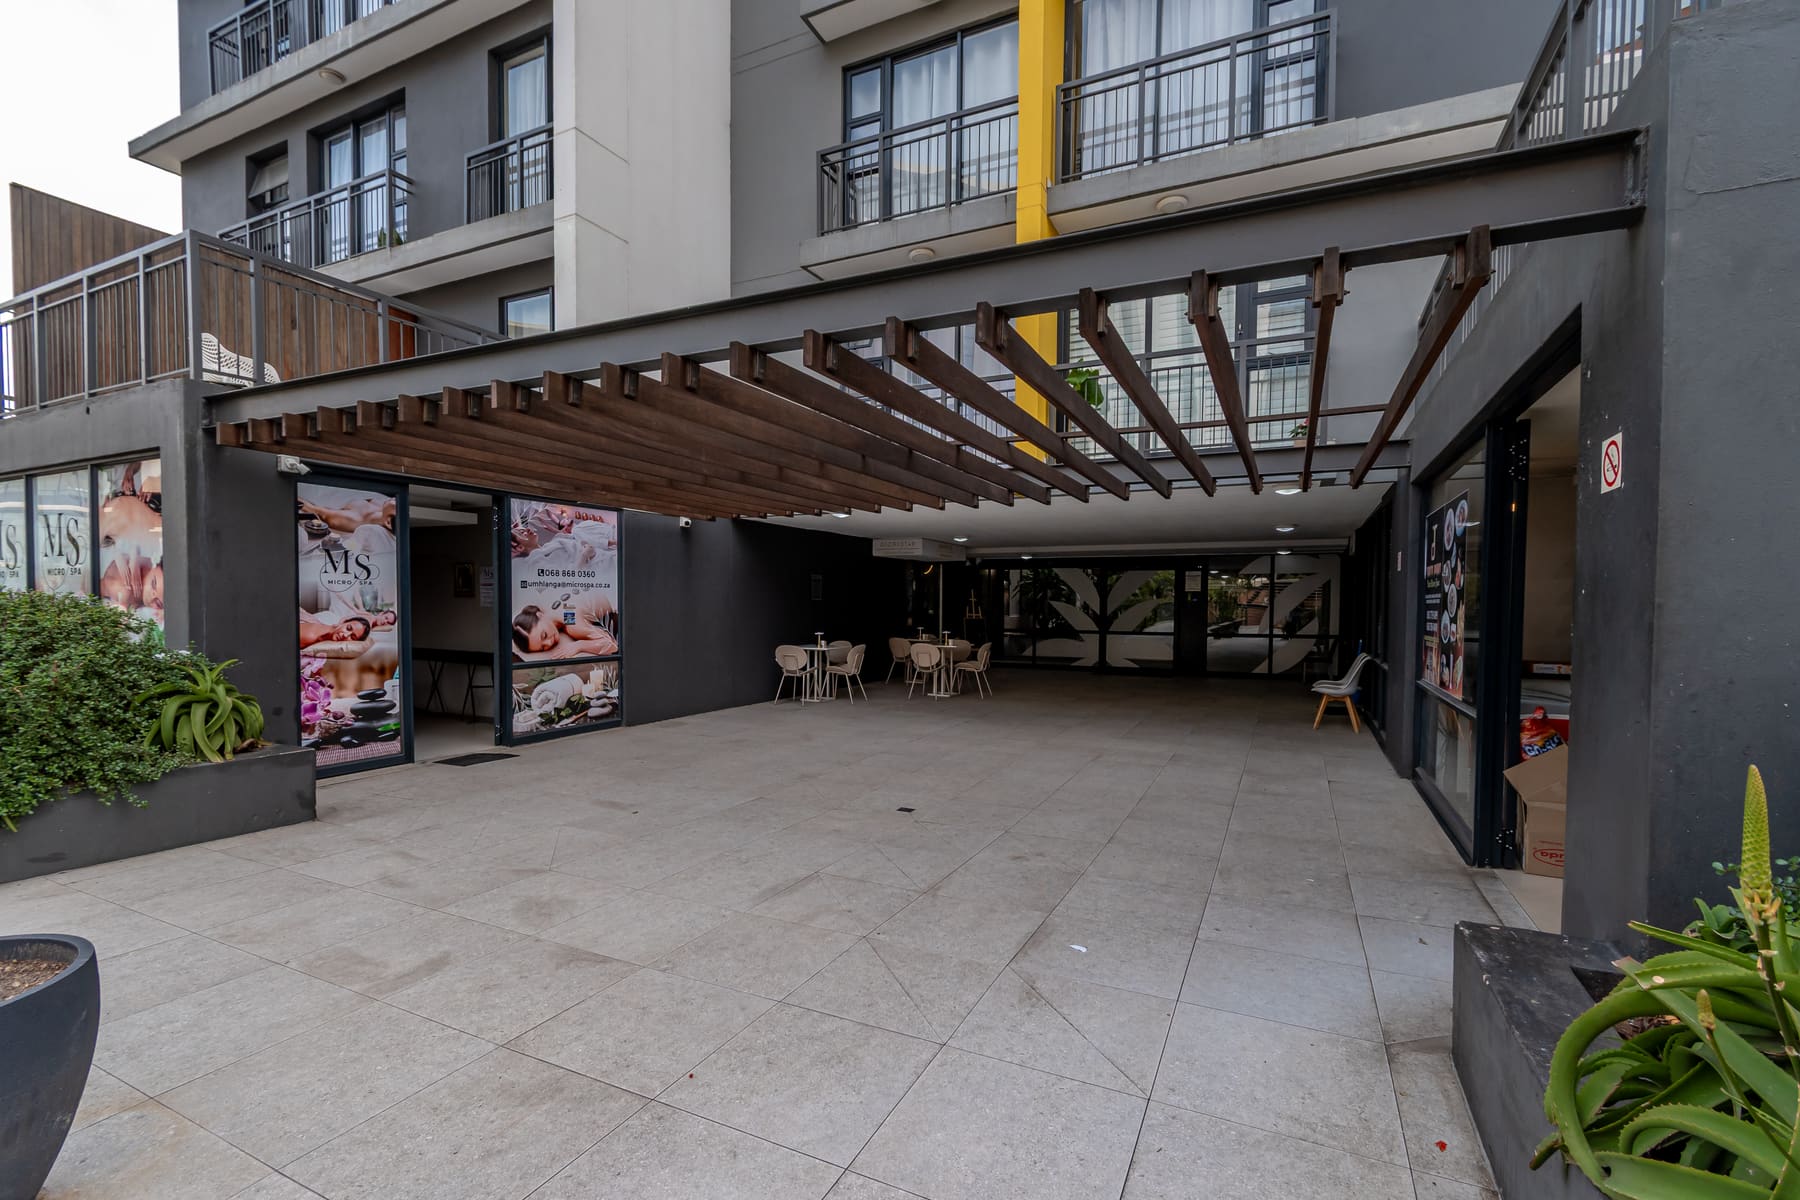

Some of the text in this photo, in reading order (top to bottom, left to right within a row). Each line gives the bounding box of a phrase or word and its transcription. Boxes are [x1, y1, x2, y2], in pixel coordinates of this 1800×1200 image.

[41, 512, 80, 567] MS
[322, 548, 372, 581] MS
[544, 569, 560, 577] 068
[561, 569, 576, 577] 868
[527, 580, 611, 589] umhlanga@microspa.co.za
